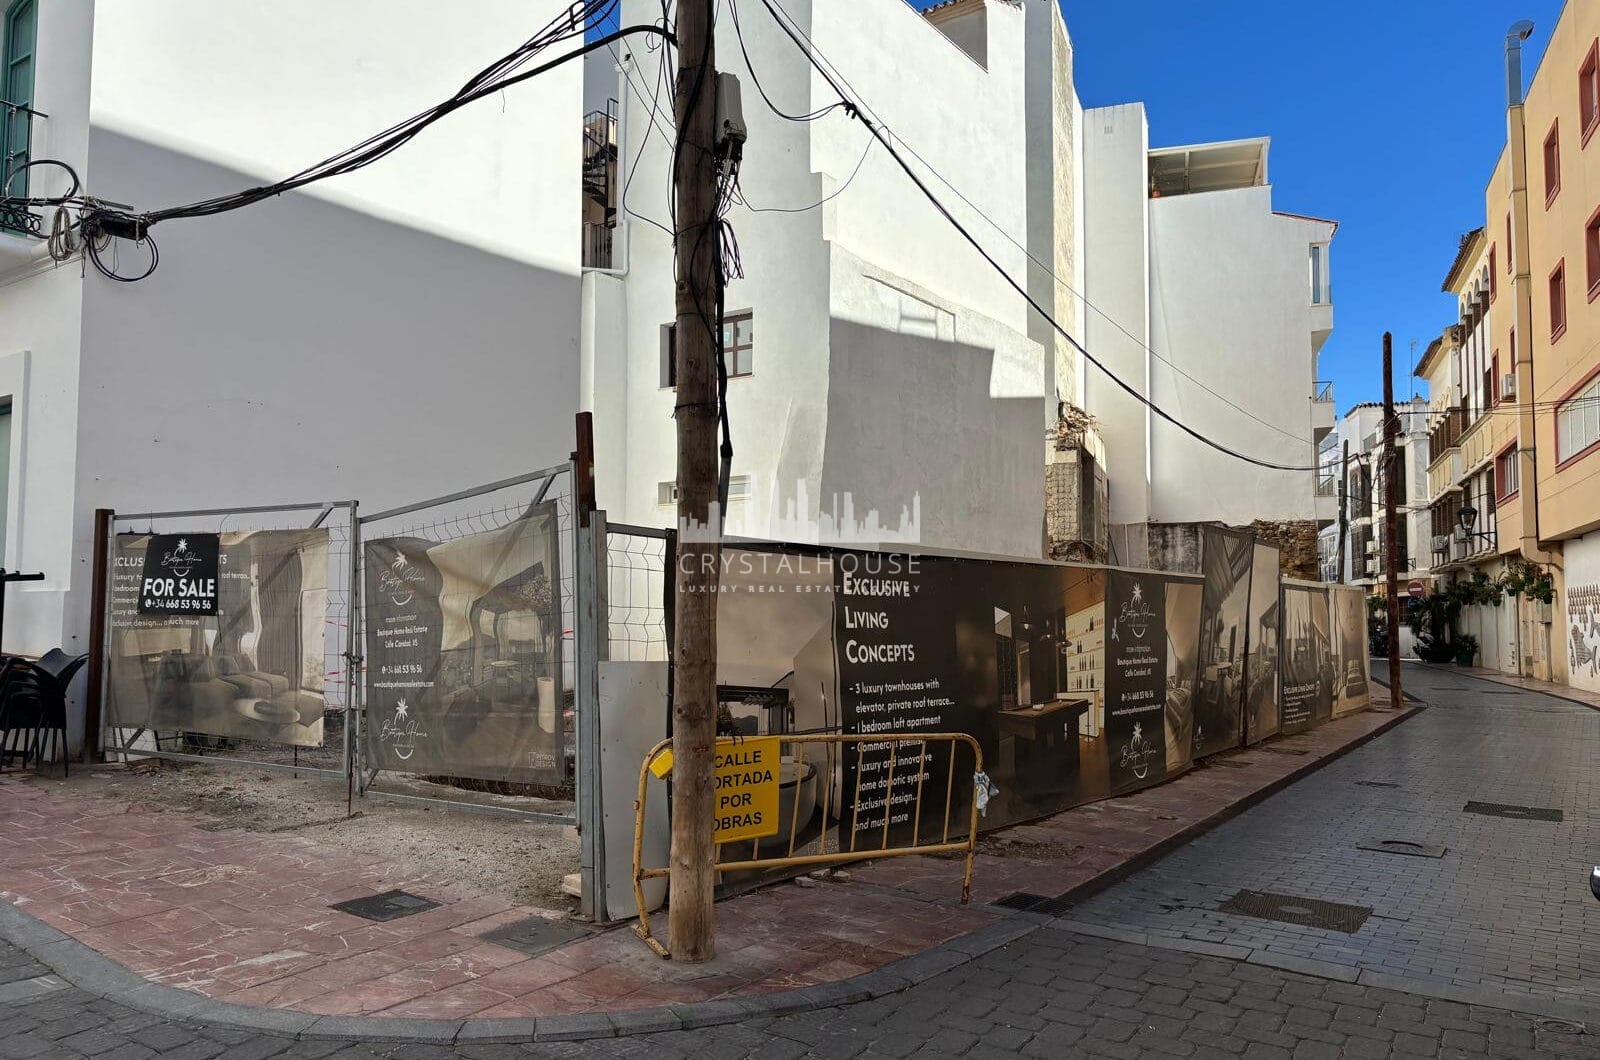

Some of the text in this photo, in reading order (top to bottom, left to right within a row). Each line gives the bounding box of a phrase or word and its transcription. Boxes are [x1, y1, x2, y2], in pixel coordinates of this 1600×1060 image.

[143, 578, 215, 598] FOR SALE
[151, 600, 211, 609] +34 668 53 96 56
[855, 683, 860, 694] 3
[862, 681, 883, 695] luxury
[885, 681, 924, 693] townhouses
[925, 679, 939, 690] with
[888, 700, 911, 713] private
[913, 697, 926, 708] roof
[862, 720, 892, 733] bedroom
[893, 718, 905, 730] loft
[907, 715, 941, 729] apartment
[857, 741, 898, 753] Commercil
[715, 751, 762, 768] CALLE
[859, 759, 881, 772] uxury
[898, 753, 932, 766] innovave
[878, 775, 905, 788] dootic
[907, 772, 930, 785] systm
[720, 793, 752, 809] POR
[891, 815, 909, 824] more
